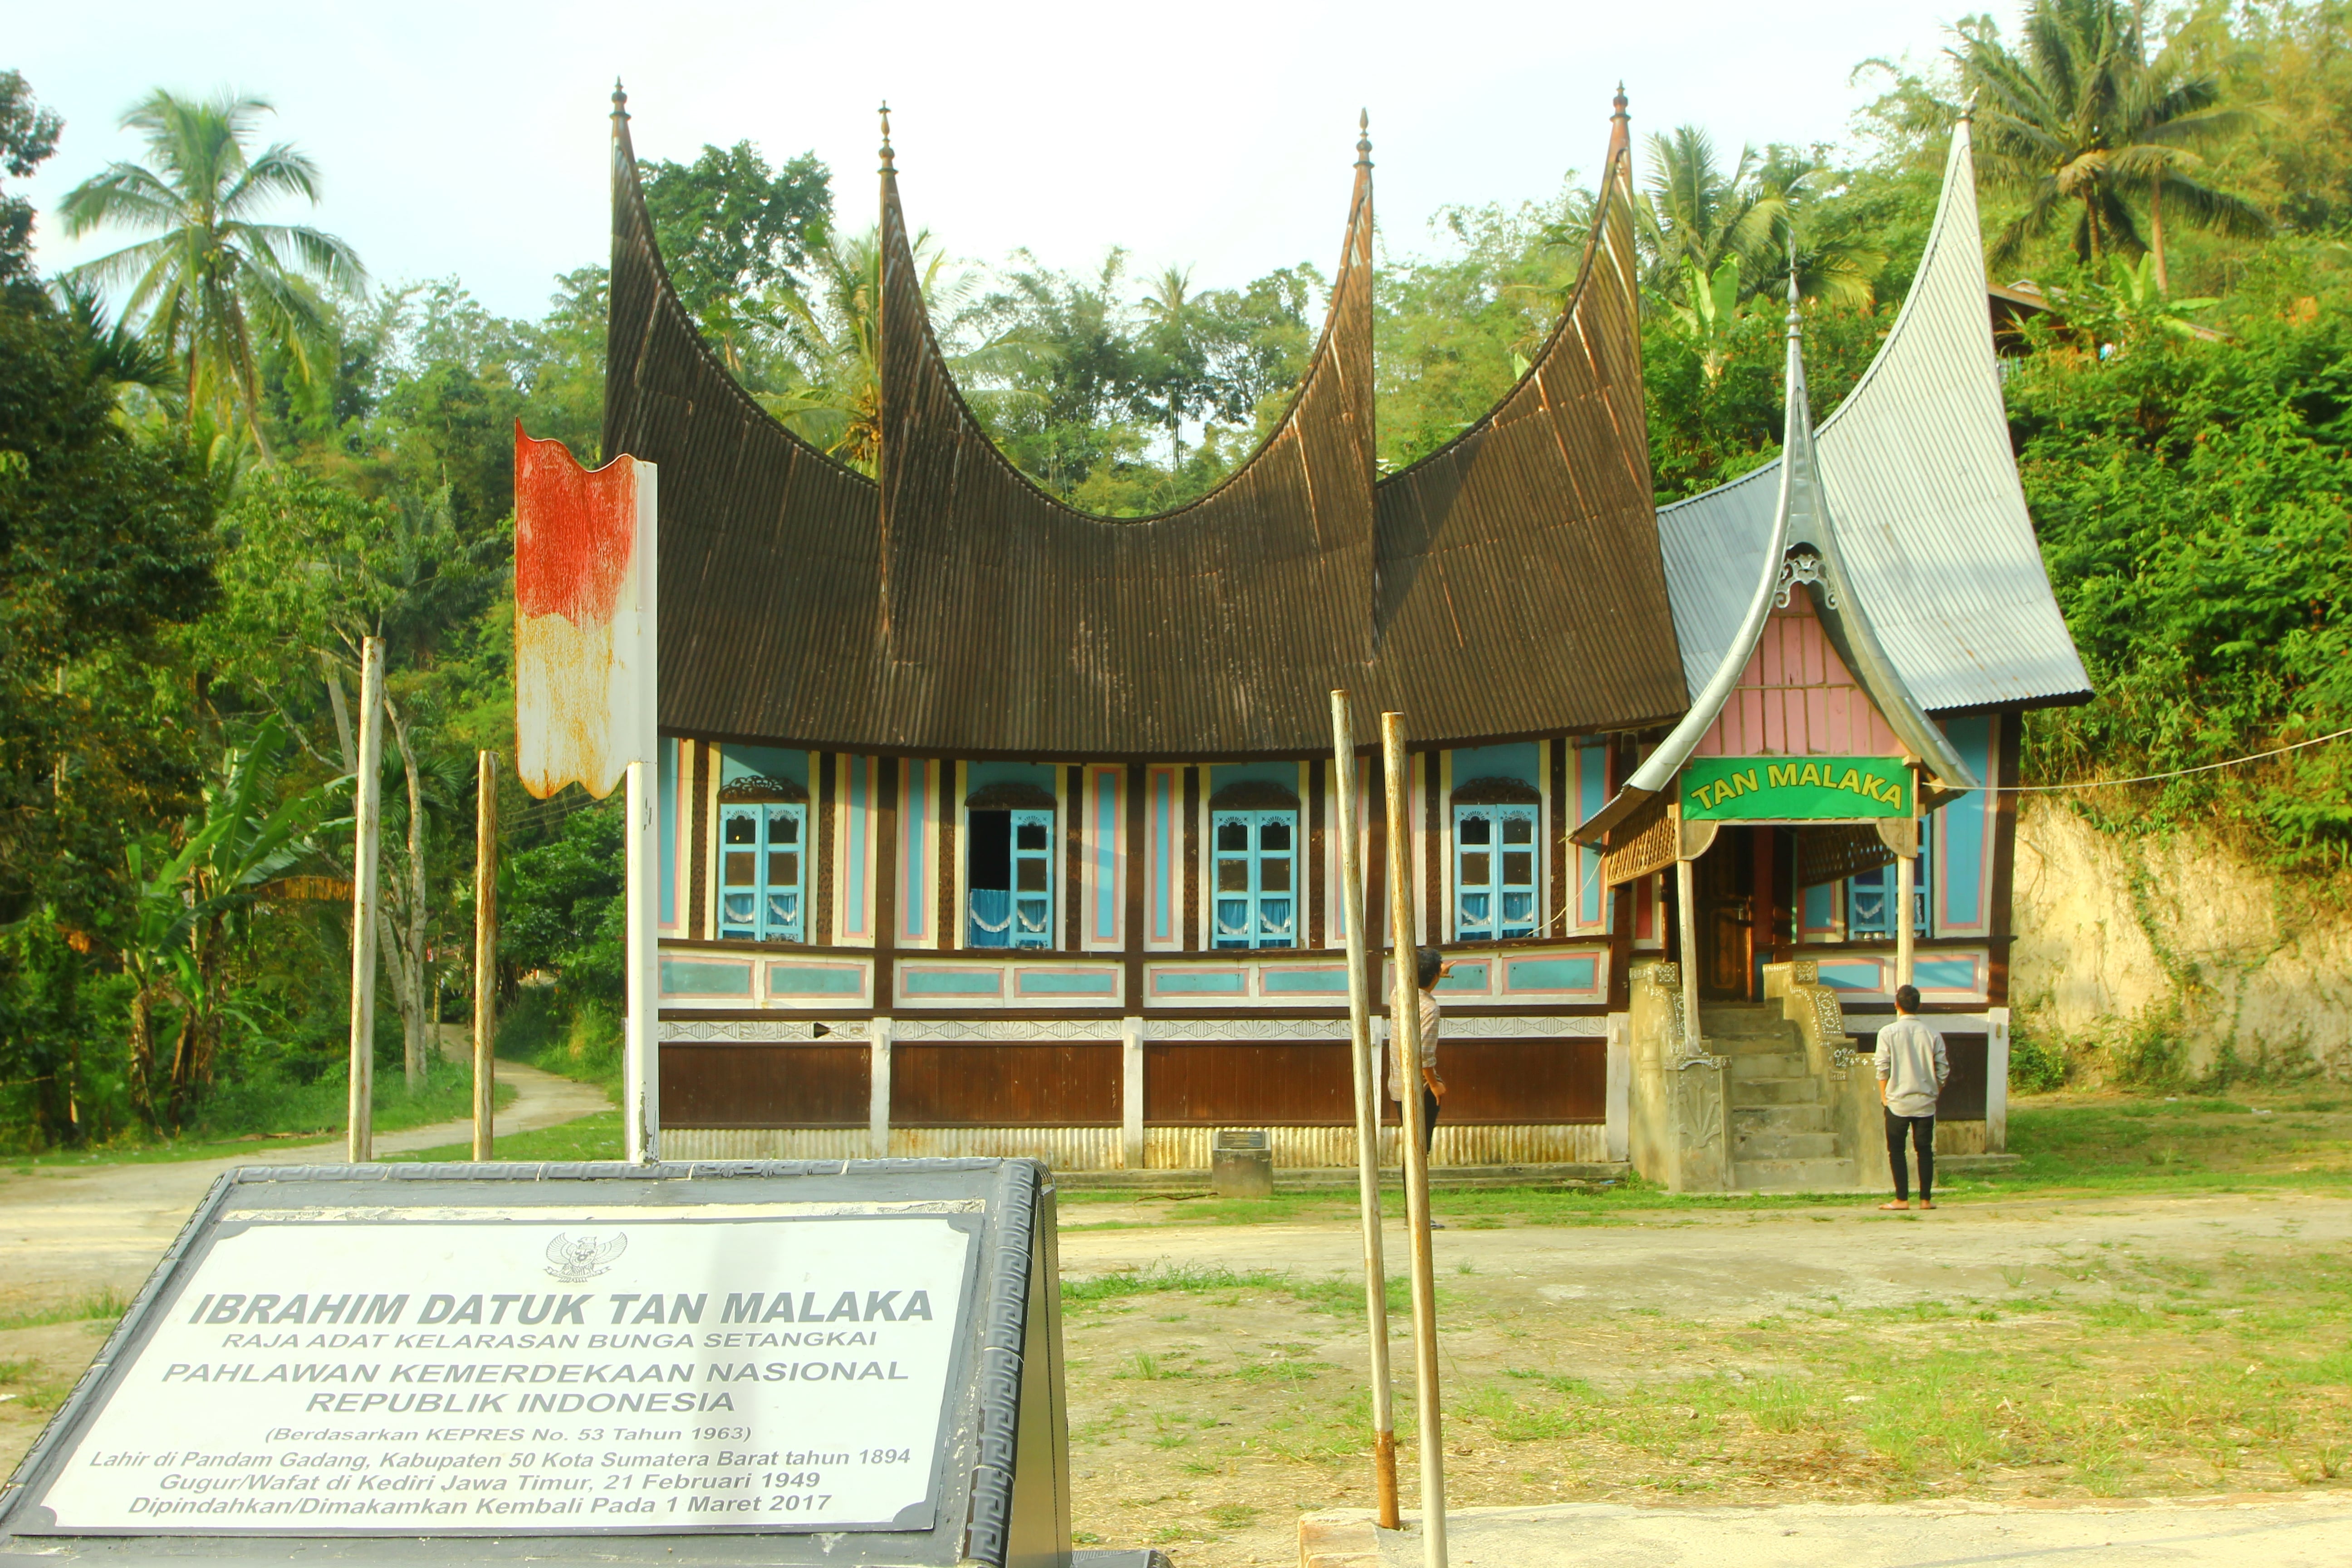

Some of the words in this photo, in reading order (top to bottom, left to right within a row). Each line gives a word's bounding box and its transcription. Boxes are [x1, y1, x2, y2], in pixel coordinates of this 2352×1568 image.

[1690, 769, 1759, 810] TAN
[1767, 763, 1902, 811] MALAKA
[188, 1294, 410, 1324] IBRAHIM
[416, 1294, 595, 1325] DATUK
[609, 1293, 709, 1325] TAN
[720, 1290, 933, 1324] MALAKA
[221, 1333, 299, 1348] RAJA
[305, 1334, 390, 1348] ADAT
[394, 1334, 580, 1349] KELARASAN
[587, 1333, 694, 1348] BUNGA
[703, 1331, 877, 1348] SETANGKAI
[162, 1363, 381, 1382] PAHLAWAN
[389, 1363, 695, 1383] KEMERDEKAAN
[706, 1361, 909, 1382] NASIONAL
[305, 1392, 508, 1413] REPUBLIK
[517, 1392, 735, 1413] INDONESIA
[265, 1428, 419, 1443] (Berdasarkan
[426, 1428, 525, 1441] KEPRES
[531, 1428, 568, 1441] No.
[578, 1428, 604, 1441] 53
[613, 1428, 682, 1441] Tahun
[692, 1426, 751, 1443] 1963)
[89, 1451, 151, 1467] Lahir
[153, 1451, 177, 1467] di
[180, 1451, 273, 1467] Pandam
[279, 1451, 370, 1471] Gadang,
[379, 1452, 502, 1472] Kabupaten
[508, 1452, 536, 1468] 50
[541, 1452, 594, 1468] Kota
[600, 1451, 710, 1467] Sumatera
[716, 1450, 779, 1466] Barat
[785, 1450, 850, 1465] tahun
[859, 1448, 910, 1465] 1894
[160, 1474, 320, 1494] Gugur/Wafat
[326, 1475, 353, 1490] di
[357, 1475, 436, 1491] Kediri
[440, 1475, 508, 1493] Jawa
[519, 1475, 593, 1492] Timur,
[603, 1474, 633, 1490] 21
[642, 1472, 753, 1490] Februari
[762, 1472, 820, 1488] 1949
[128, 1497, 468, 1517] Dipindahkan/Dimakamkan
[475, 1497, 584, 1514] Kembali
[590, 1497, 656, 1514] Pada
[666, 1496, 678, 1513] 1
[687, 1495, 762, 1512] Maret
[769, 1494, 833, 1511] 2017
